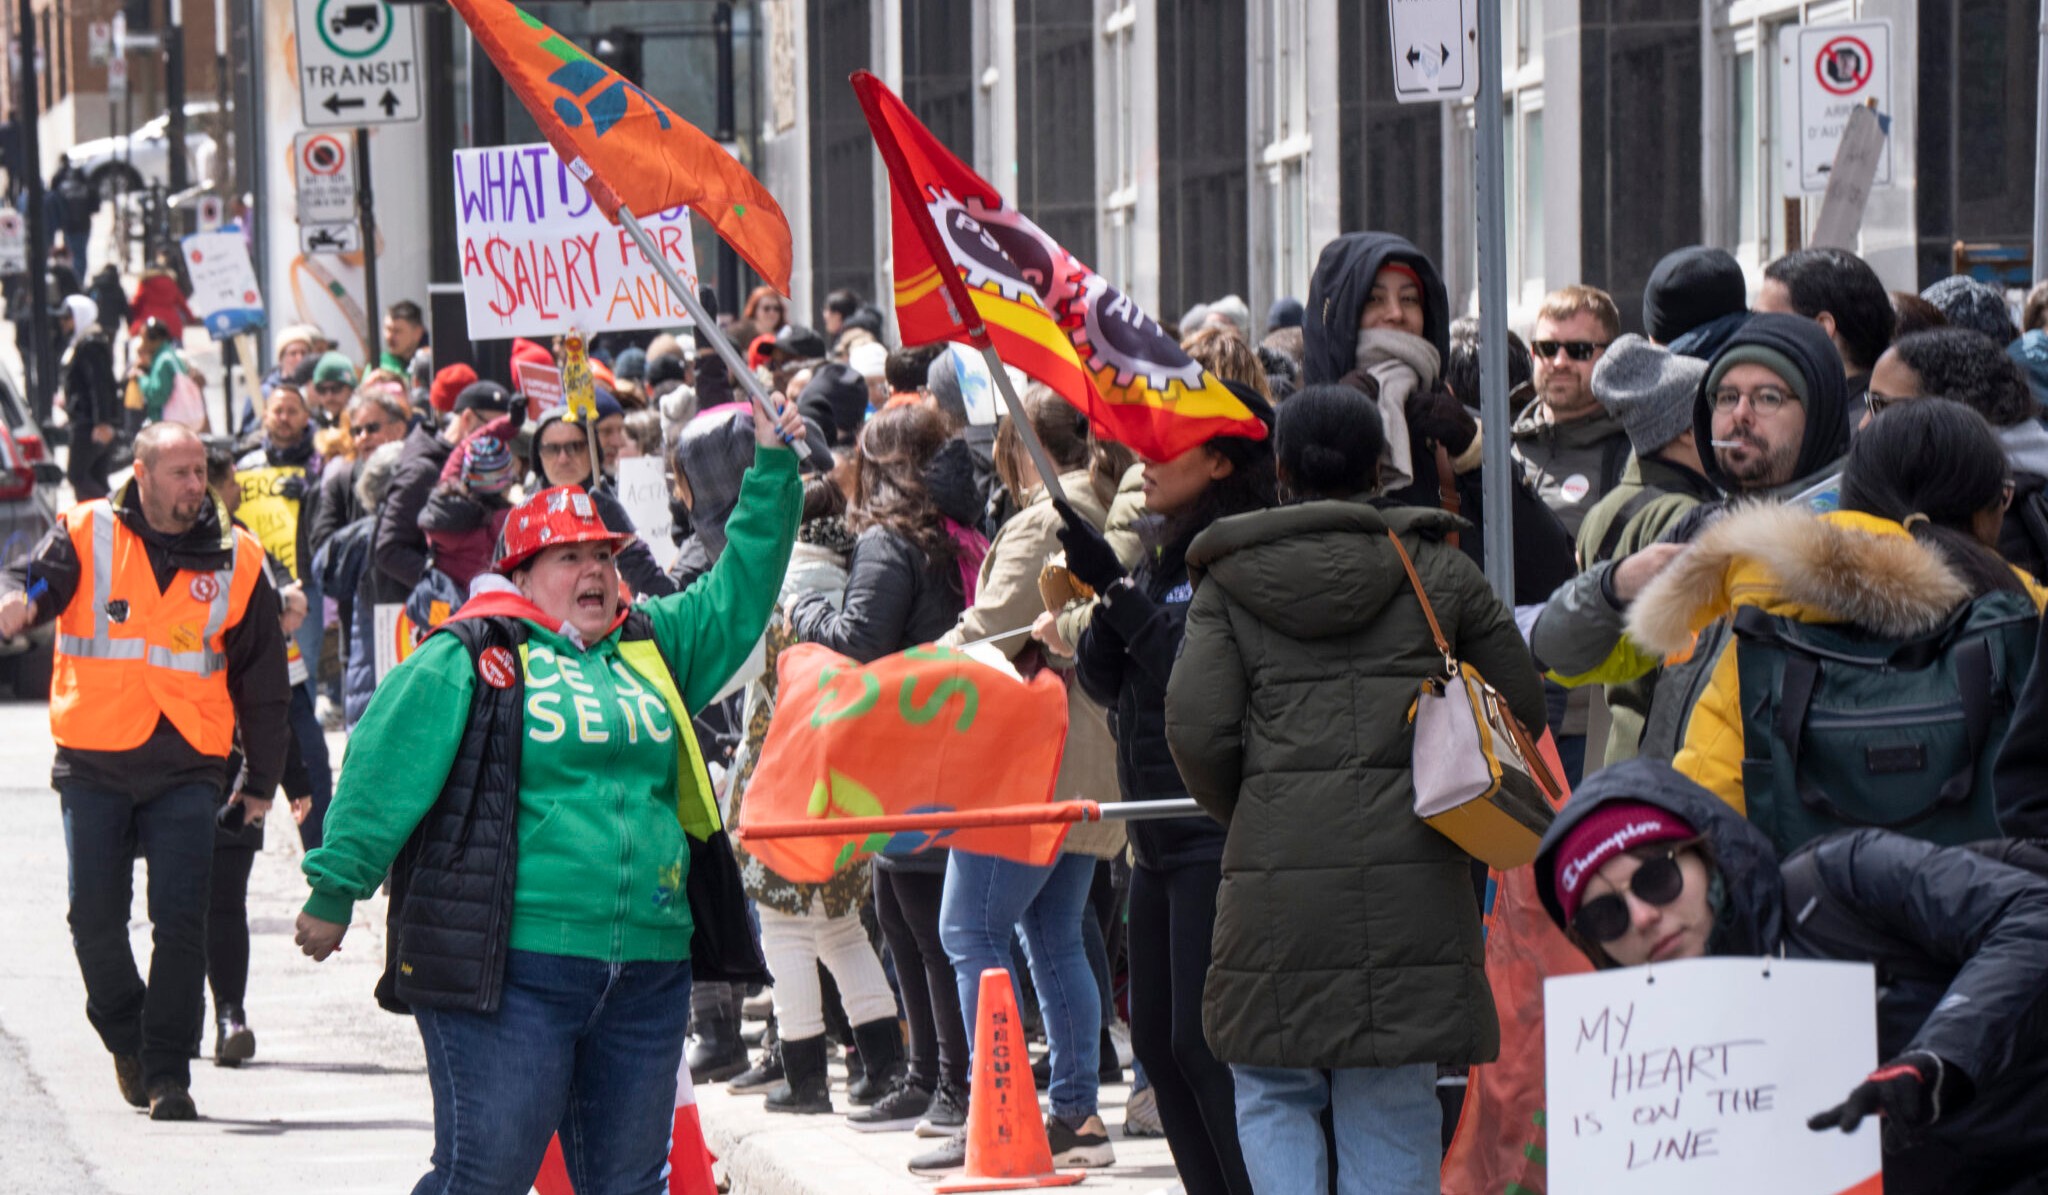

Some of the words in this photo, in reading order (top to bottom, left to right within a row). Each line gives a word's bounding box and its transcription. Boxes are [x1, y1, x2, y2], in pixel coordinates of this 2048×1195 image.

[306, 61, 412, 87] TRANSIT
[456, 148, 549, 224] WHAT
[464, 237, 483, 276] A
[528, 691, 672, 743] SEIC
[1562, 821, 1661, 892] Champion
[1575, 1001, 1634, 1057] MY
[1611, 1037, 1767, 1101] HEART
[1573, 1112, 1602, 1138] IS
[1632, 1096, 1680, 1126] ON
[1706, 1083, 1776, 1115] THE
[1626, 1128, 1719, 1171] LINE
